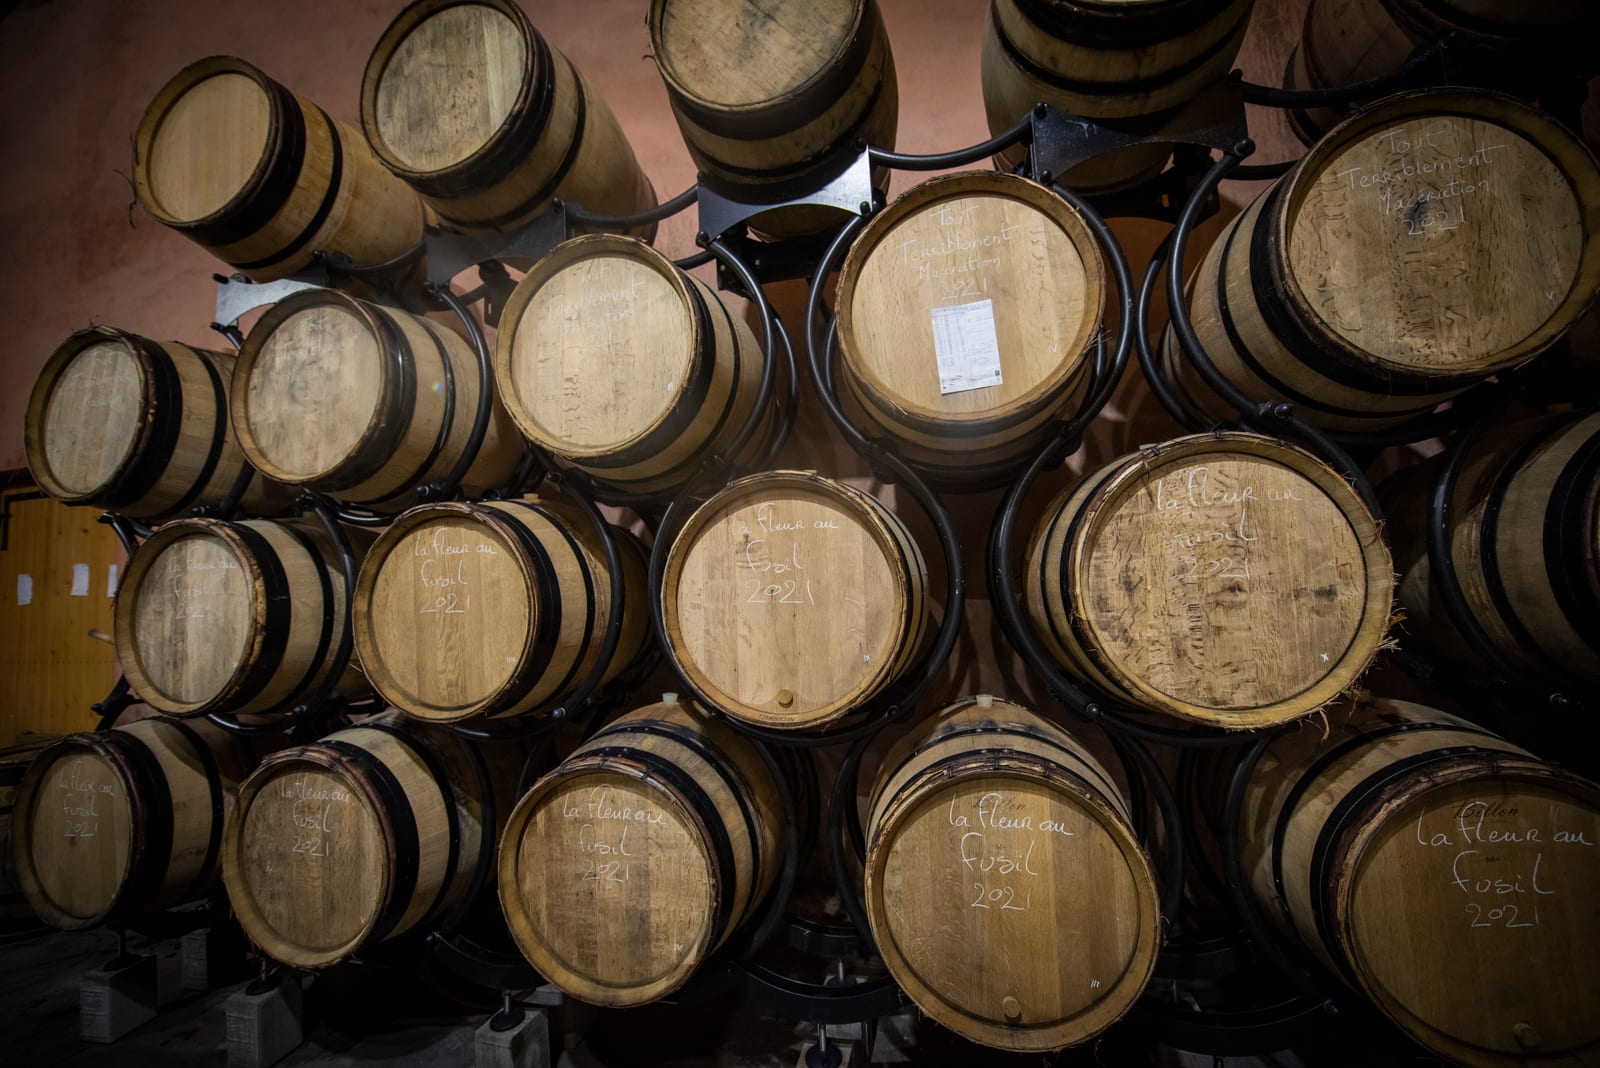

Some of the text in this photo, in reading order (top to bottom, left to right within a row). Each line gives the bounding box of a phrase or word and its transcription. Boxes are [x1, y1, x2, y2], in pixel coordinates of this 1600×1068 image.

[1401, 204, 1466, 235] 2021
[813, 519, 840, 530] au
[476, 543, 497, 555] au
[419, 592, 471, 613] 2021
[745, 579, 815, 607] 2021
[634, 809, 667, 825] au
[1039, 819, 1074, 836] au
[64, 820, 99, 837] 2021
[1553, 829, 1594, 846] au
[292, 835, 329, 856] 2021
[578, 859, 629, 882] 2021
[971, 882, 1031, 911] 2021
[1465, 904, 1540, 928] 2021
